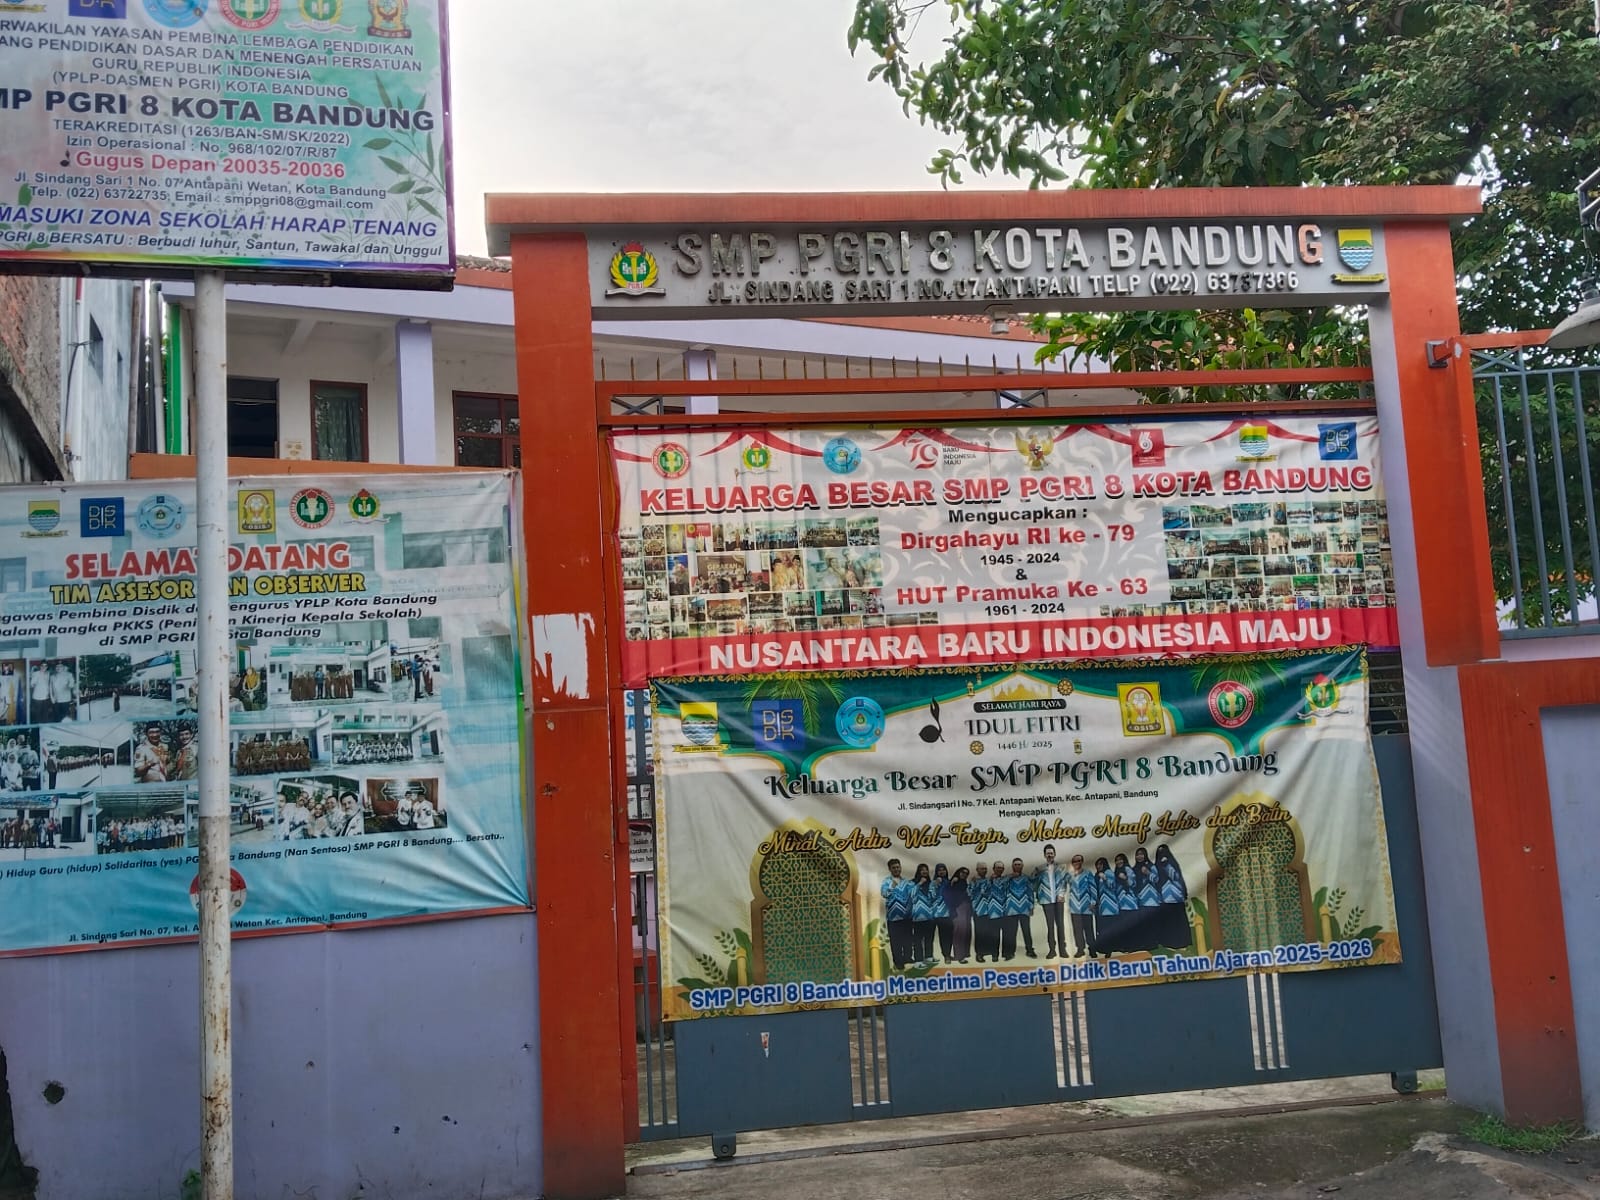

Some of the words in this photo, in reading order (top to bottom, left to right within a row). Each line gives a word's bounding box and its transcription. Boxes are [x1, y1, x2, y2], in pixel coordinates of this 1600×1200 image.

[91, 25, 163, 41] YAYASAN
[169, 31, 238, 45] PEMBINA
[243, 34, 318, 50] LEMBAGA
[323, 40, 414, 56] PENDIDIKAN
[38, 37, 137, 54] PENDIDIKAN
[143, 44, 196, 59] DASAR
[202, 47, 234, 61] DAN
[240, 49, 327, 66] MENENGAH
[332, 56, 422, 72] PERSATUAN
[92, 57, 138, 71] GURU
[143, 60, 222, 75] REPUBLIK
[227, 65, 312, 80] INDONESIA
[53, 71, 173, 88] (YPLP-DASMEN
[178, 78, 221, 92] PGRI)
[226, 80, 268, 94] KOTA
[272, 84, 348, 98] BANDUNG
[46, 89, 127, 115] PGRI
[140, 95, 159, 116] 8
[171, 96, 262, 122] KOTA
[273, 102, 435, 130] BANDUNG
[53, 119, 177, 136] TERAKREDITASI
[181, 123, 350, 146] (1263/BAN-SM/SK/2022)
[66, 135, 92, 147] Izin
[97, 136, 186, 151] Operasional
[200, 141, 221, 153] No.
[228, 142, 337, 158] 968/102/07/R/87
[76, 151, 144, 170] Gugus
[152, 154, 216, 173] Depan
[223, 158, 345, 178] 20035-20036
[31, 186, 62, 198] Telp.
[66, 188, 100, 200] (022)
[175, 191, 212, 202] Email
[225, 194, 373, 210] smppgri08@gmail.com
[35, 173, 91, 186] Sindang
[95, 174, 122, 185] Sari
[138, 176, 160, 187] No.
[185, 178, 243, 192] Antapani
[249, 181, 292, 193] Wetan,
[296, 184, 325, 194] Kota
[330, 185, 386, 199] Bandung
[89, 209, 151, 226] ZONA
[159, 211, 265, 231] SEKOLAH
[271, 216, 346, 234] HARAP
[353, 219, 437, 237] TENANG
[36, 232, 45, 243] 8
[49, 232, 124, 245] BERSATU
[138, 235, 195, 248] Berbudi
[200, 236, 240, 250] luhur,
[246, 238, 299, 252] Santun,
[305, 241, 360, 254] Tawakal
[364, 243, 389, 255] dan
[394, 244, 442, 258] Unggul
[676, 233, 778, 276] SMP
[798, 230, 911, 275] PGRI
[928, 230, 955, 272] 8
[973, 227, 1090, 271] KOTA
[1107, 223, 1324, 269] BANDUNG
[744, 280, 834, 301] SINDANG
[845, 279, 892, 300] SARI
[984, 275, 1081, 298] ANTAPANI
[1089, 274, 1141, 295] TELP
[1149, 271, 1199, 294] (022)
[640, 484, 818, 512] KELUARGA
[828, 480, 934, 506] BESAR
[944, 477, 1009, 500] SMP
[1020, 475, 1094, 498] PGRI
[1104, 474, 1123, 495] 8
[1133, 470, 1216, 494] KOTA
[1223, 466, 1372, 491] BANDUNG
[948, 507, 1077, 524] Mengucapkan
[900, 529, 1019, 552] Dirgahayu
[1027, 527, 1050, 545] RI
[1059, 526, 1086, 544] ke
[1107, 524, 1135, 542] 79
[65, 546, 198, 579] SELAMA
[980, 554, 1014, 566] 1945
[1026, 552, 1060, 564] 2024
[1015, 568, 1028, 580] &
[49, 584, 91, 605] TIM
[96, 579, 196, 603] ASSESOR
[254, 572, 366, 595] OBSERVER
[896, 586, 948, 605] HUT
[956, 583, 1059, 602] Pramuka
[1067, 581, 1098, 597] Ke
[1120, 578, 1148, 595] 63
[59, 605, 130, 619] Pembina
[133, 603, 180, 616] Disdik
[294, 598, 330, 609] YPLP
[335, 596, 368, 607] Kota
[373, 594, 437, 606] Bandung
[984, 605, 1018, 617] 1961
[1031, 602, 1065, 614] 2024
[47, 622, 107, 635] Rangka
[113, 620, 154, 631] PKKS
[241, 613, 296, 625] Kinerja
[301, 611, 354, 624] Kepala
[359, 608, 422, 620] Sekolah)
[99, 635, 114, 646] di
[119, 634, 153, 646] SMP
[158, 632, 195, 643] PGRI
[254, 627, 321, 639] Bandung
[710, 634, 927, 670] NUSANTARA
[937, 629, 1031, 658] BARU
[1043, 621, 1231, 652] INDONESIA
[1240, 616, 1333, 644] MAJU
[981, 702, 1017, 711] SELAMAT
[1019, 701, 1039, 710] HARI
[1041, 700, 1061, 709] RAYA
[964, 718, 1021, 735] IDUL
[1026, 715, 1080, 733] FITRI
[1032, 740, 1052, 749] 2025
[764, 773, 879, 799] Keluarga
[884, 770, 957, 791] Besar
[970, 759, 1041, 791] SMP
[1047, 758, 1128, 789] PGRI
[1135, 756, 1151, 780] 8
[1157, 751, 1279, 778] Bandung
[909, 800, 957, 811] Sindangsari
[1000, 796, 1035, 806] Antapani
[1123, 788, 1159, 798] Bandung
[999, 807, 1055, 818] Mengucapkan
[759, 829, 819, 855] Minal
[1017, 818, 1085, 843] Mohon
[1155, 810, 1200, 836] Lahir
[1206, 806, 1239, 828] dan
[1245, 802, 1292, 825] Batin
[6, 868, 36, 879] Hidup
[39, 866, 64, 875] Guru
[66, 863, 102, 875] (hidup)
[105, 859, 158, 871] Solidaritas
[160, 857, 183, 868] (yes)
[238, 849, 281, 860] Bandung
[284, 846, 309, 859] (Nan
[311, 844, 351, 855] Sentosa)
[353, 840, 375, 851] SMP
[376, 839, 400, 849] PGRI
[81, 932, 117, 942] Sindang
[119, 929, 137, 938] Sari
[285, 915, 328, 925] Antapani,
[329, 911, 367, 921] Bandung
[691, 989, 733, 1009] SMP
[737, 985, 782, 1007] PGRI
[786, 984, 799, 1003] 8
[803, 979, 886, 1002] Bandung
[889, 973, 981, 995] Menerima
[984, 969, 1056, 988] Peserta
[1060, 961, 1105, 982] Didik
[1109, 958, 1152, 979] Baru
[1155, 953, 1210, 975] Tahun
[1215, 949, 1272, 972] Ajaran
[1276, 940, 1373, 964] 2025-2026
